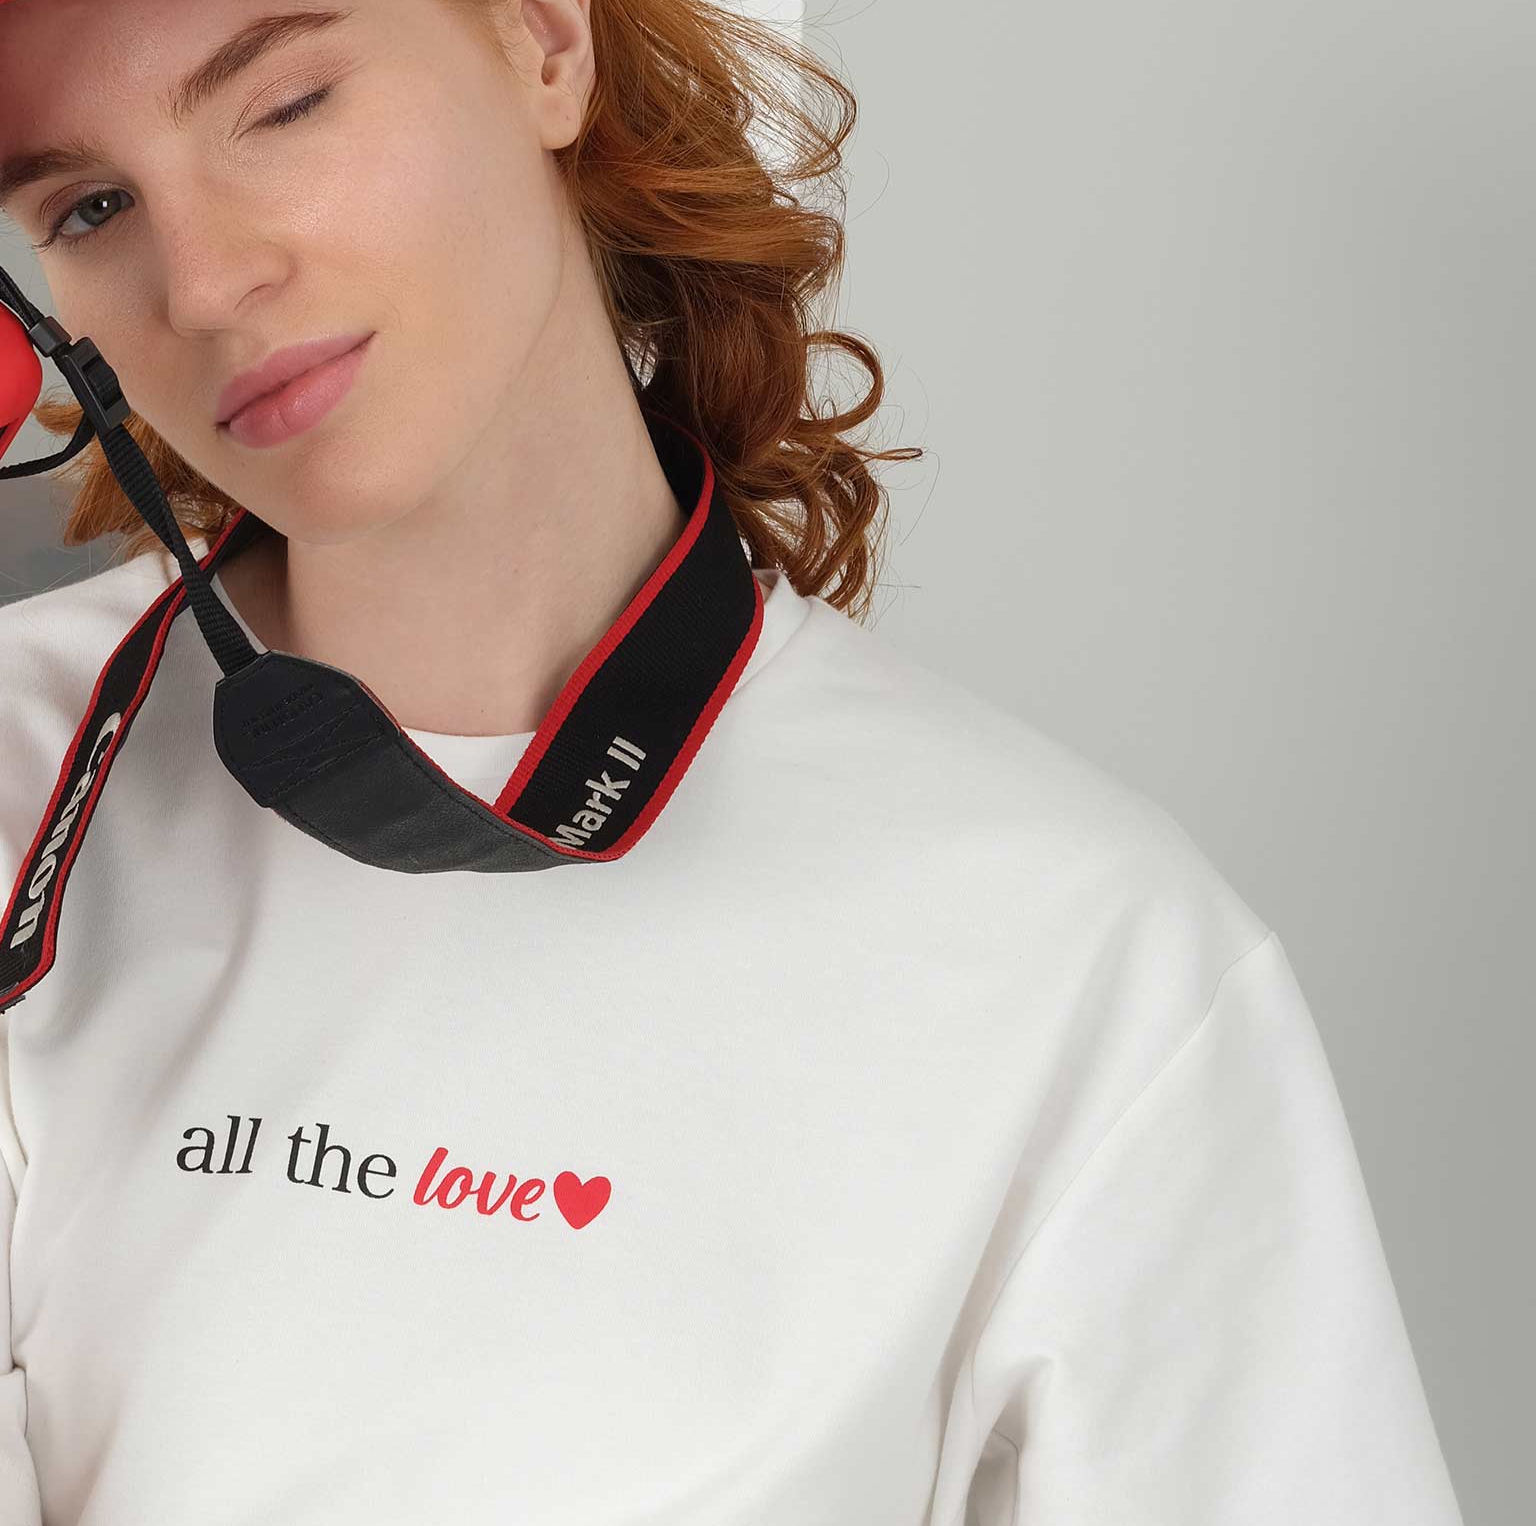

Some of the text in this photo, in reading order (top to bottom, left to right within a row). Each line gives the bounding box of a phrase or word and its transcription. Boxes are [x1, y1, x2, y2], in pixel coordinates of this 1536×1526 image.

[9, 712, 121, 950] Canon
[548, 736, 646, 850] Mark II
[176, 1114, 546, 1222] all the love
